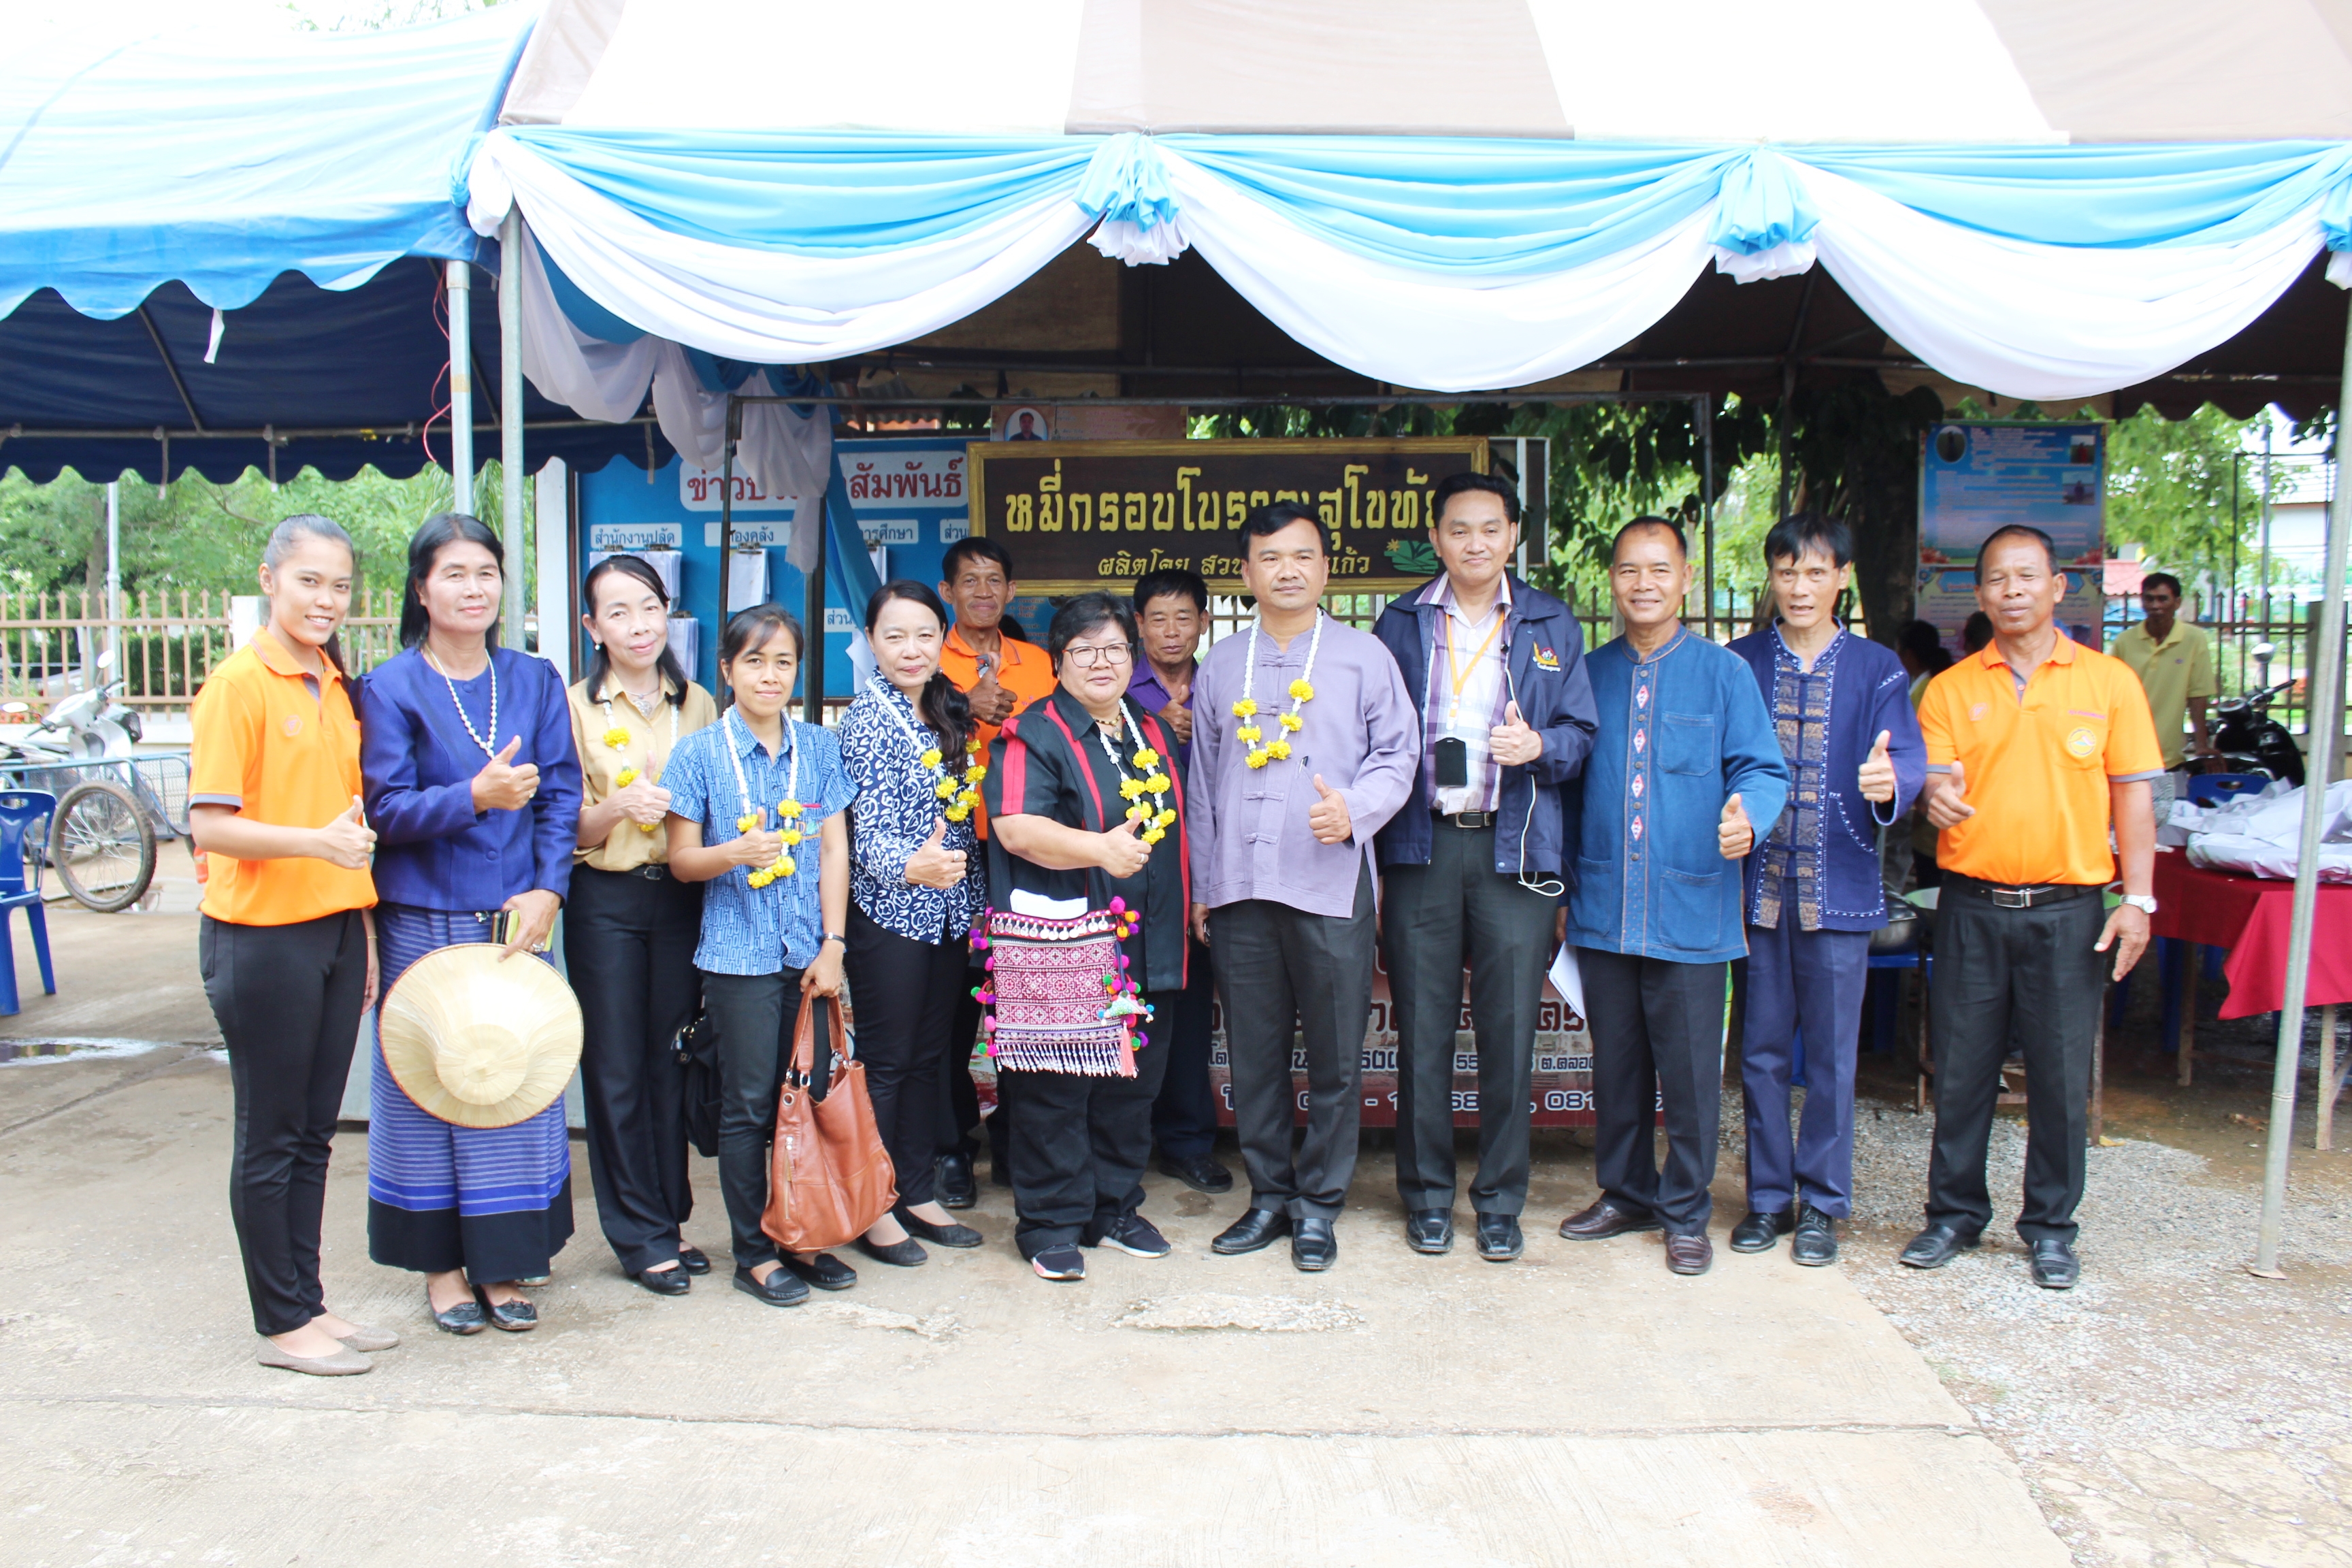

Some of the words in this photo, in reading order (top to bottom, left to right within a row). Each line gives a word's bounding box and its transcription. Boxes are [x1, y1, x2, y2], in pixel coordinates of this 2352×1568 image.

[595, 527, 674, 545] สำนักงานปลัด
[860, 523, 913, 540] ารศึกษา
[945, 523, 970, 539] ส่วน
